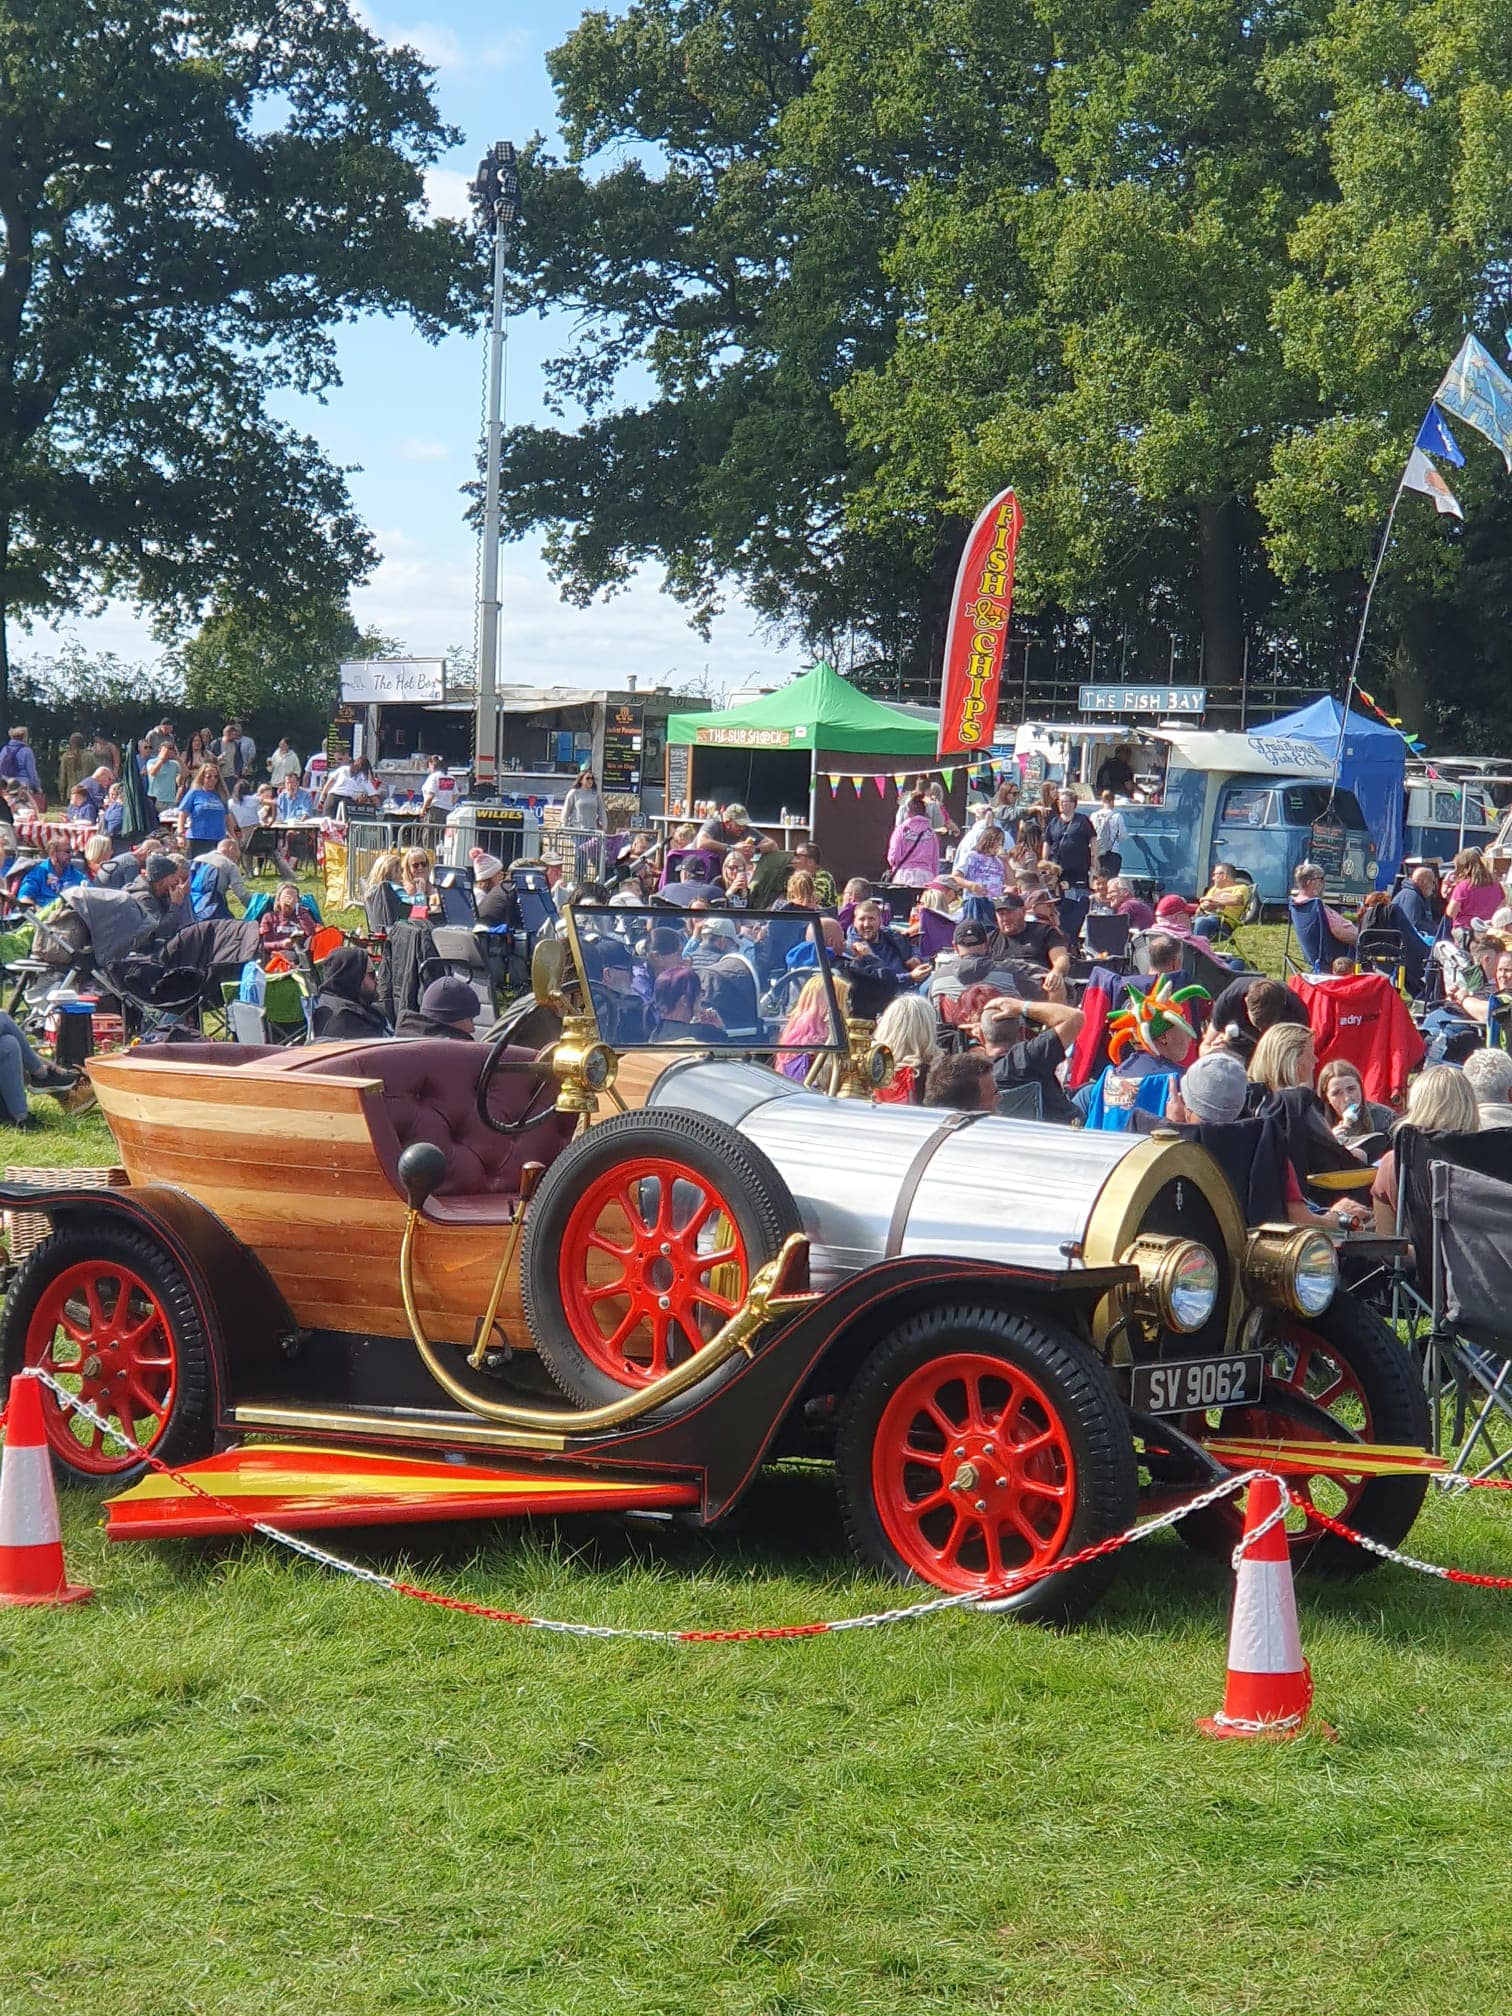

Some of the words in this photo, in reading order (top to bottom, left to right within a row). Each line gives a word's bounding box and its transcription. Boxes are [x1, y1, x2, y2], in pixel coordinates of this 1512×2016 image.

[979, 503, 1014, 597] FISH
[973, 598, 1003, 630] &
[373, 674, 392, 690] The
[396, 674, 415, 690] Hot
[417, 673, 438, 690] Box
[959, 631, 997, 744] CHIPS
[1084, 691, 1116, 708] THE
[1123, 691, 1160, 709] FISH
[1167, 691, 1204, 709] BAY
[709, 728, 727, 741] THE
[728, 729, 747, 743] SUB
[748, 729, 782, 745] SH@CK
[476, 809, 523, 819] WILDES
[1149, 1368, 1181, 1410] SV
[1186, 1361, 1246, 1405] 9062
